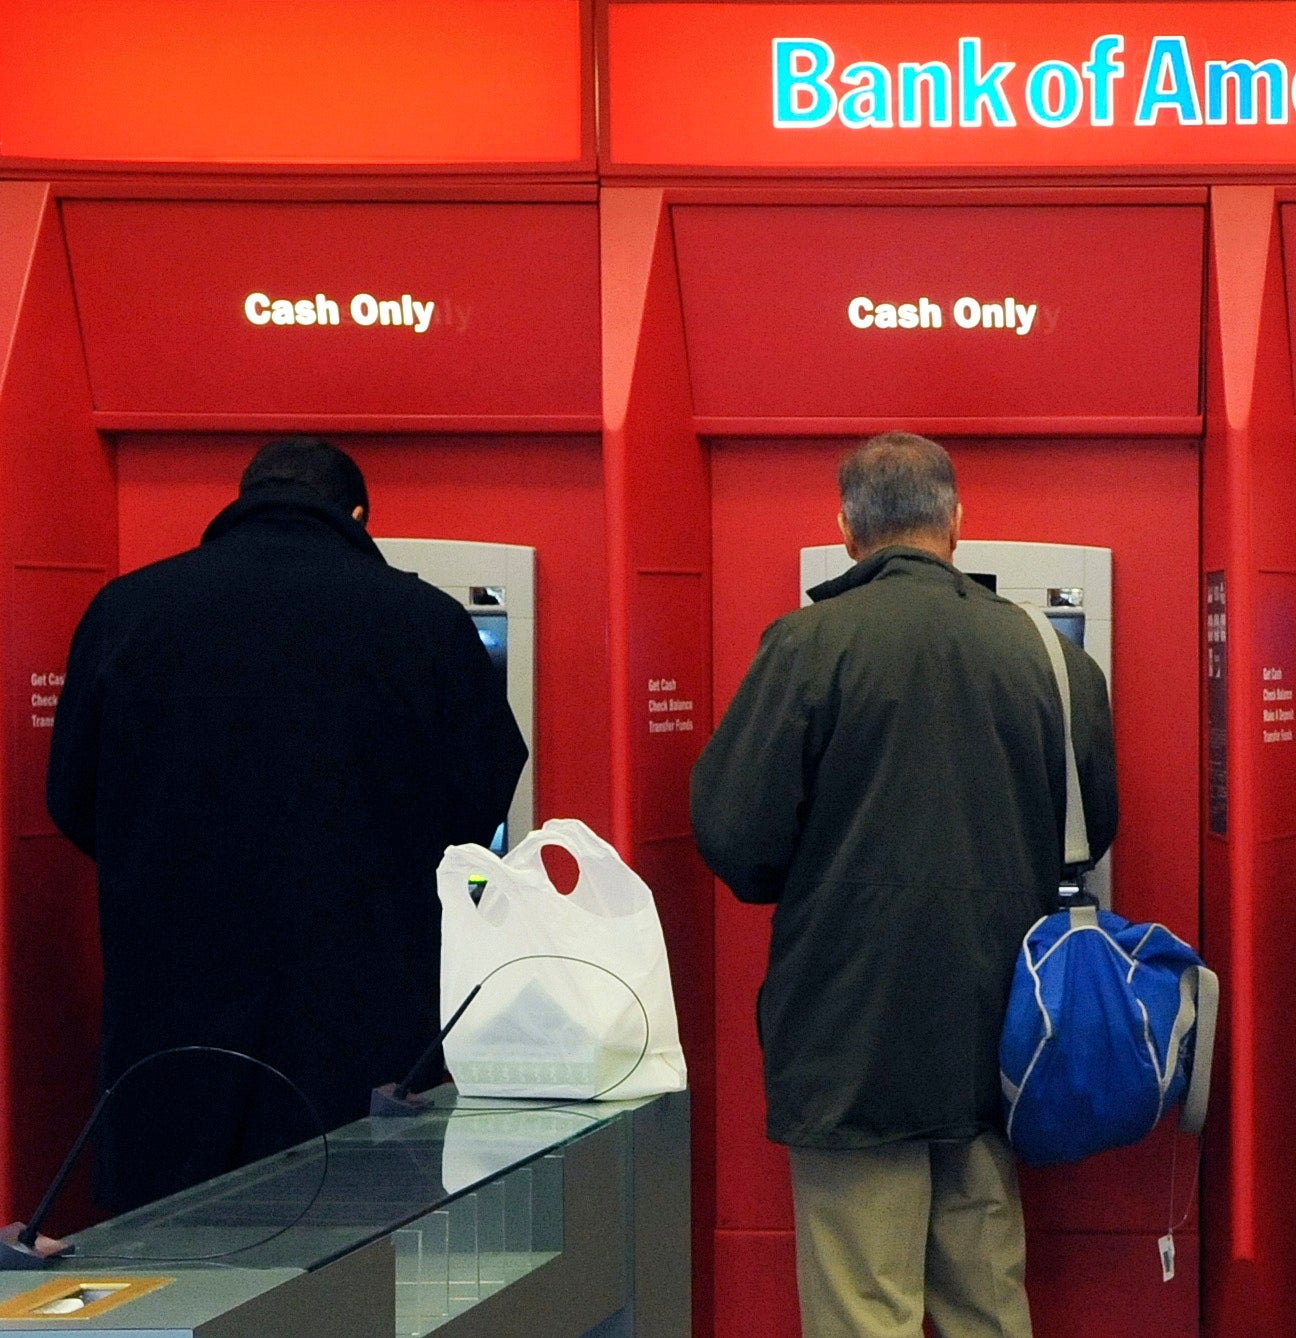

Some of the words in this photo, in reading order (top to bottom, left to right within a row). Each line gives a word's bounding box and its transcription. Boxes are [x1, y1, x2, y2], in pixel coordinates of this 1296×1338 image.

[772, 37, 1015, 128] Bank
[1026, 34, 1124, 127] of
[245, 292, 340, 325] Cash
[350, 293, 435, 333] Only
[848, 297, 942, 329] Cash
[953, 297, 1037, 336] Only
[31, 673, 47, 686] Get
[648, 679, 660, 691] Get
[661, 679, 676, 691] Cash
[649, 699, 668, 712] Check
[669, 699, 693, 711] Balance
[649, 719, 675, 733] Transfer
[676, 719, 693, 731] Funds
